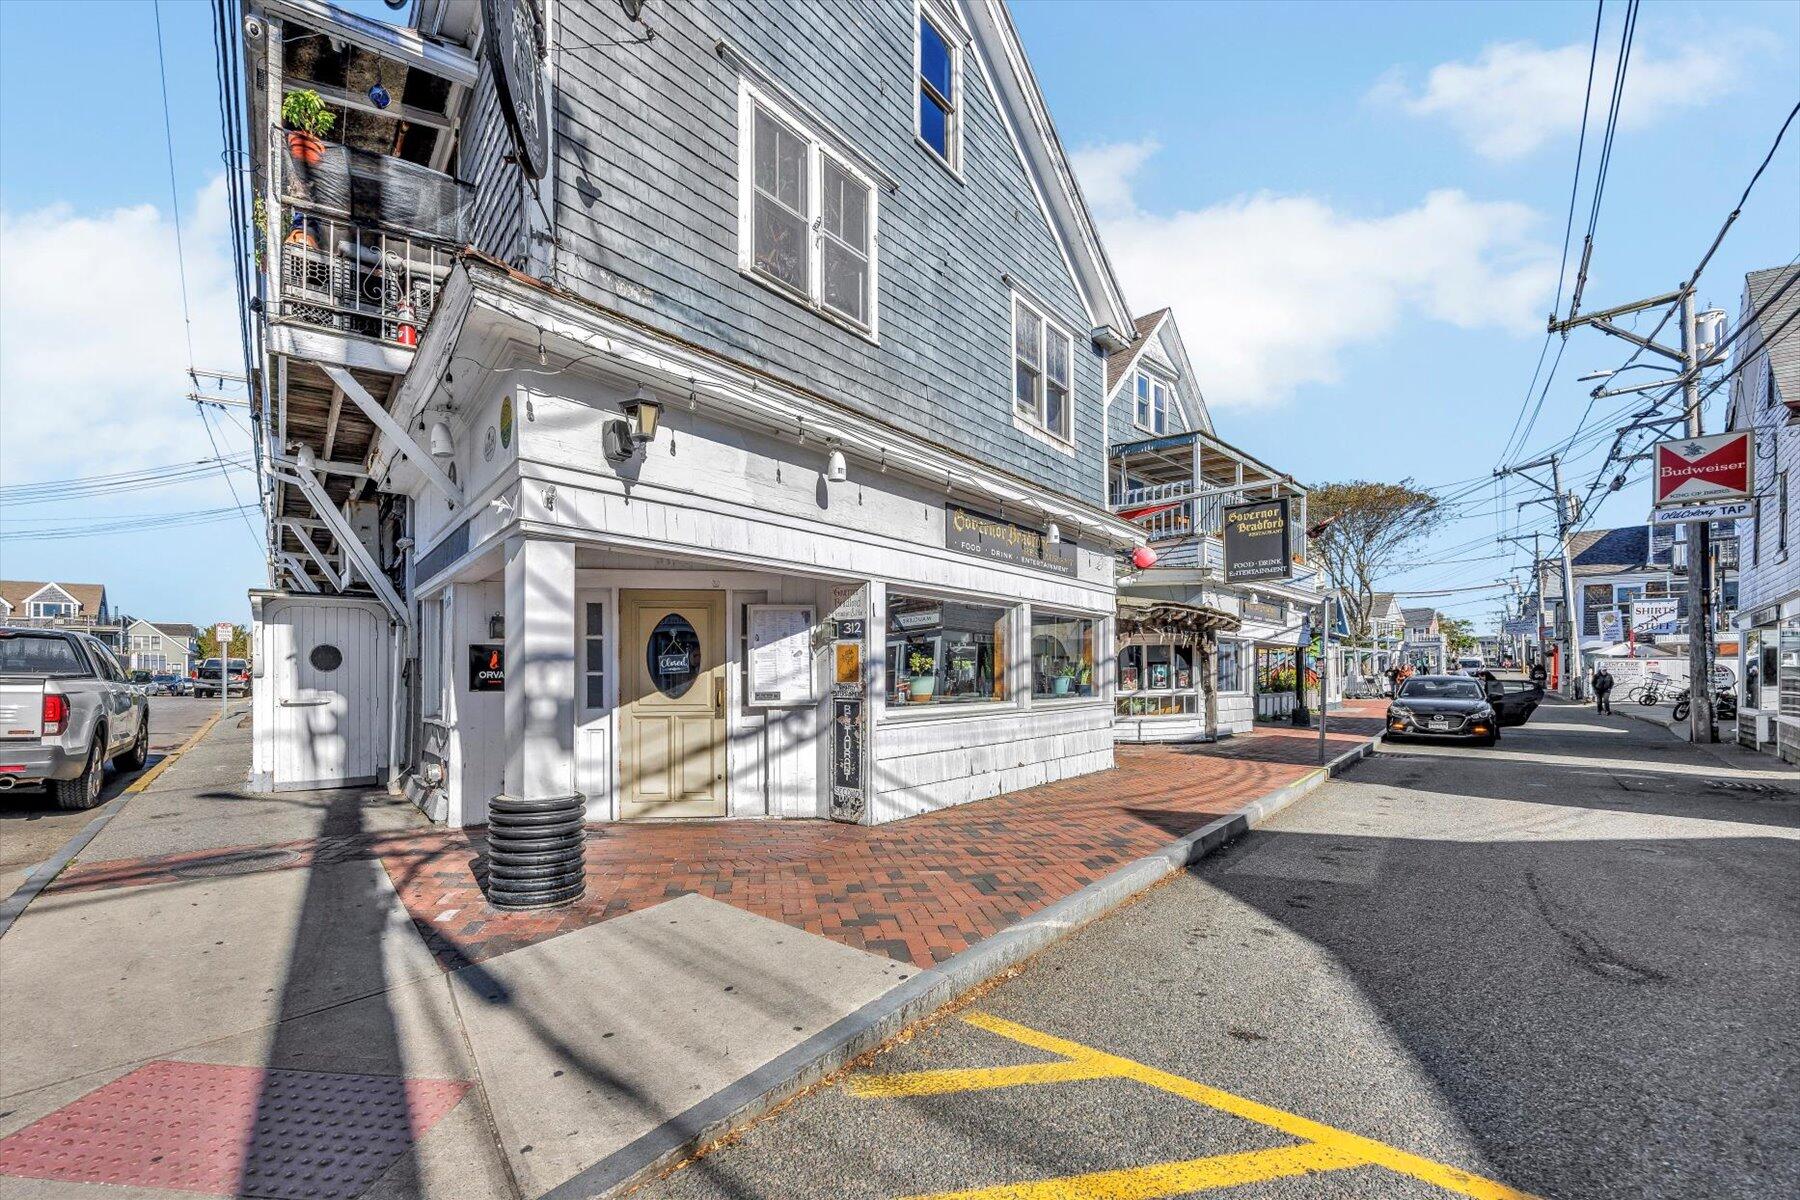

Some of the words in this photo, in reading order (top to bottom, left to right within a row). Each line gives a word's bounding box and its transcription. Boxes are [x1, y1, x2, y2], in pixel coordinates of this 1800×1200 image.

[1661, 462, 1745, 477] Budweiser
[1229, 509, 1279, 522] Governor
[1661, 509, 1682, 521] Old
[1681, 508, 1716, 519] Colony
[1720, 505, 1746, 515] TAP
[953, 508, 1006, 540] Governor
[1237, 516, 1284, 533] Bradford
[961, 541, 981, 553] FOOD
[991, 548, 1013, 560] DRINK
[1021, 556, 1069, 573] ENTERTAINMENT
[1233, 561, 1255, 569] FOOD
[1229, 566, 1287, 577] ENTERTAINMENT
[1635, 606, 1676, 615] SHIRTS
[843, 622, 862, 634] 312
[1638, 622, 1673, 631] STUFF
[661, 656, 688, 668] Closed
[478, 671, 505, 679] ORVA
